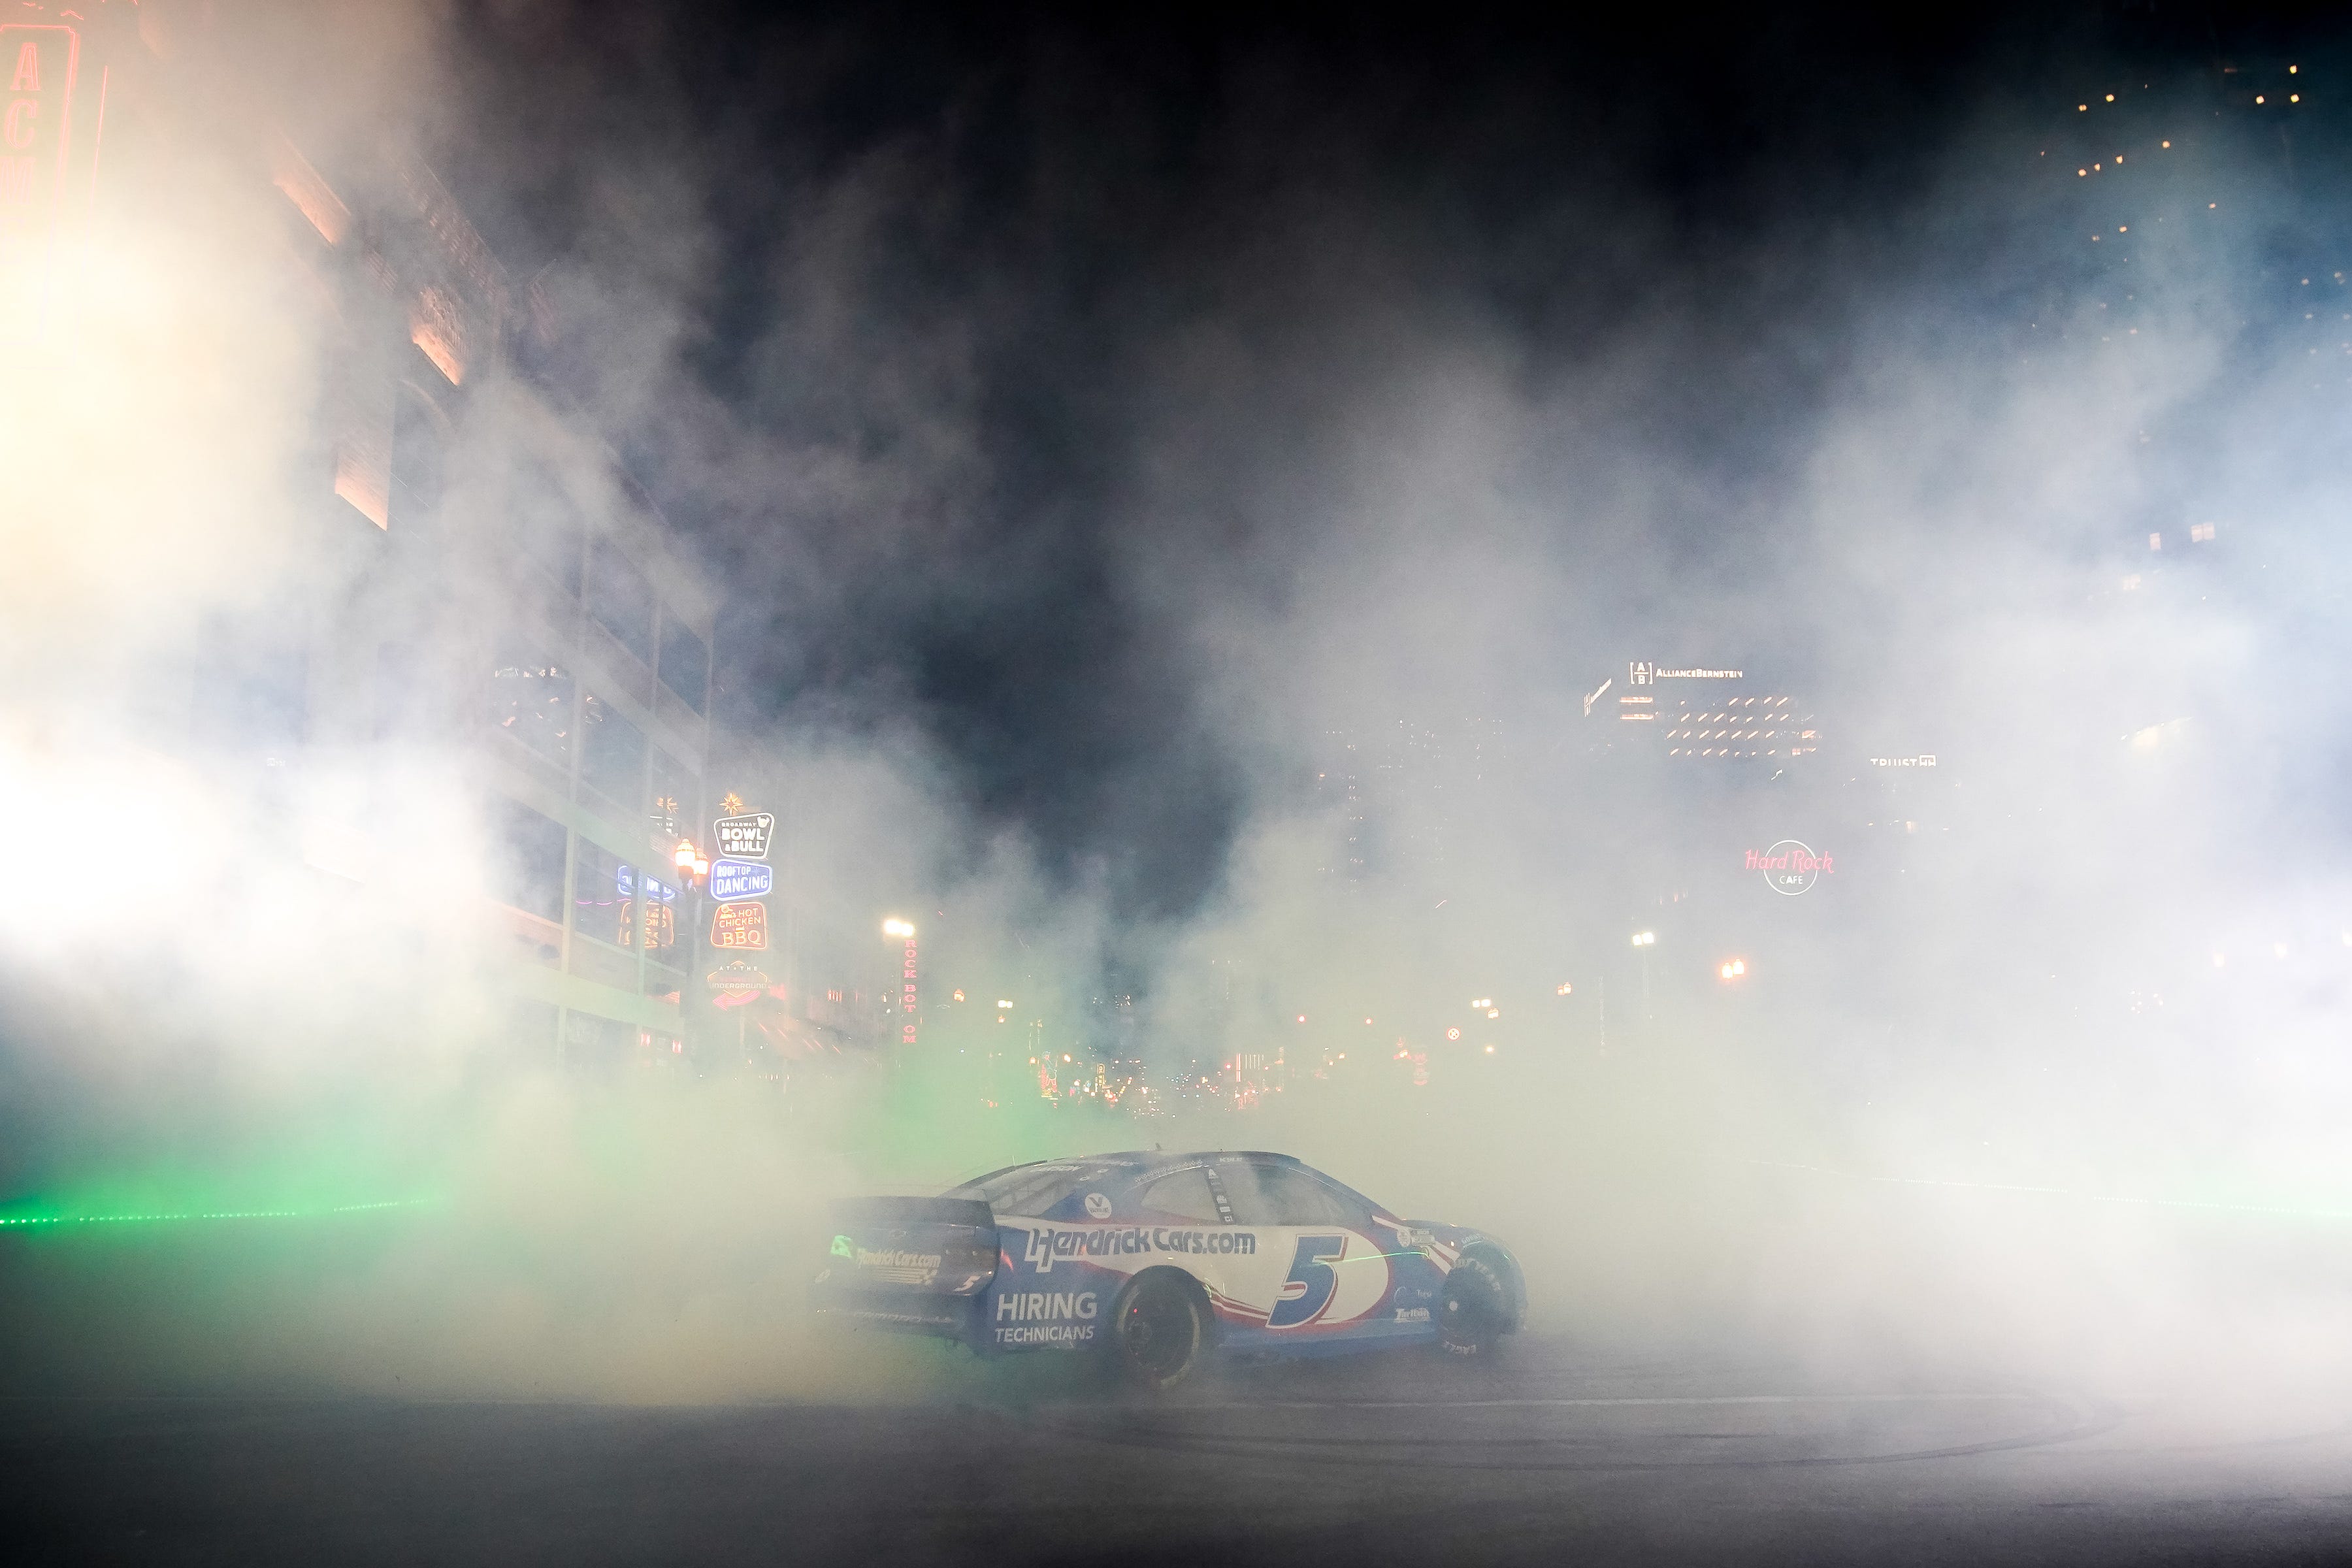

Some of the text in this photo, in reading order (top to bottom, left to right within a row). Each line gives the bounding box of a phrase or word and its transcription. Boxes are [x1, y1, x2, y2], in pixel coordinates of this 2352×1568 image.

[721, 828, 765, 841] BOWL
[1745, 849, 1834, 874] Hard Rock
[716, 866, 751, 877] ROOFTOP
[716, 874, 768, 894] DANCING
[1779, 875, 1803, 885] CAFE
[738, 907, 759, 917] HOT
[719, 916, 761, 928] CHICKEN
[721, 930, 761, 945] BBQ
[903, 939, 917, 1043] ROCK BOTOM
[1265, 1233, 1349, 1329] 5
[996, 1292, 1098, 1321] HIRING
[995, 1325, 1096, 1343] TECHNICIANS
